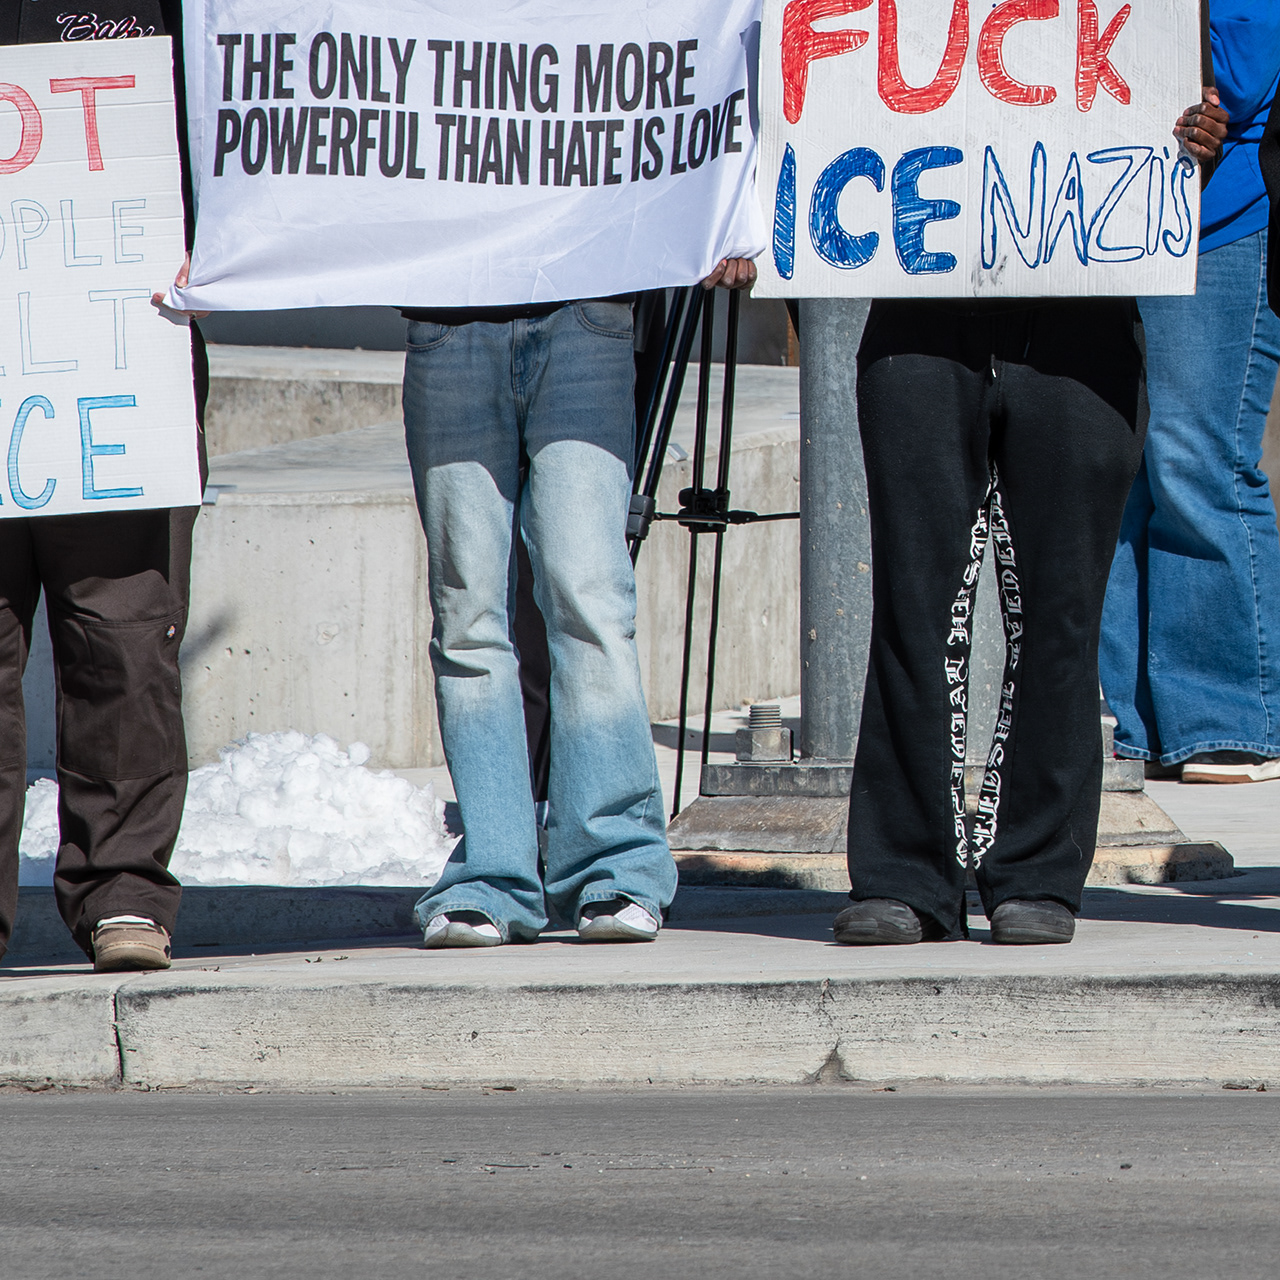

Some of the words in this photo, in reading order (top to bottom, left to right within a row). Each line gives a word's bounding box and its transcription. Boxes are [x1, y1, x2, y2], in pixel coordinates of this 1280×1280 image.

[216, 33, 296, 102] THE
[310, 31, 417, 104] ONLY
[428, 40, 559, 113] THING
[574, 38, 699, 114] MORE
[213, 107, 426, 182] POWERFUL
[435, 113, 530, 186] THAN
[540, 119, 622, 187] HATE
[631, 116, 665, 183] IS
[670, 88, 745, 177] LOVE
[0, 199, 146, 269] PLE
[772, 142, 963, 280] ICE
[0, 289, 151, 375] LT
[0, 395, 144, 509] CE
